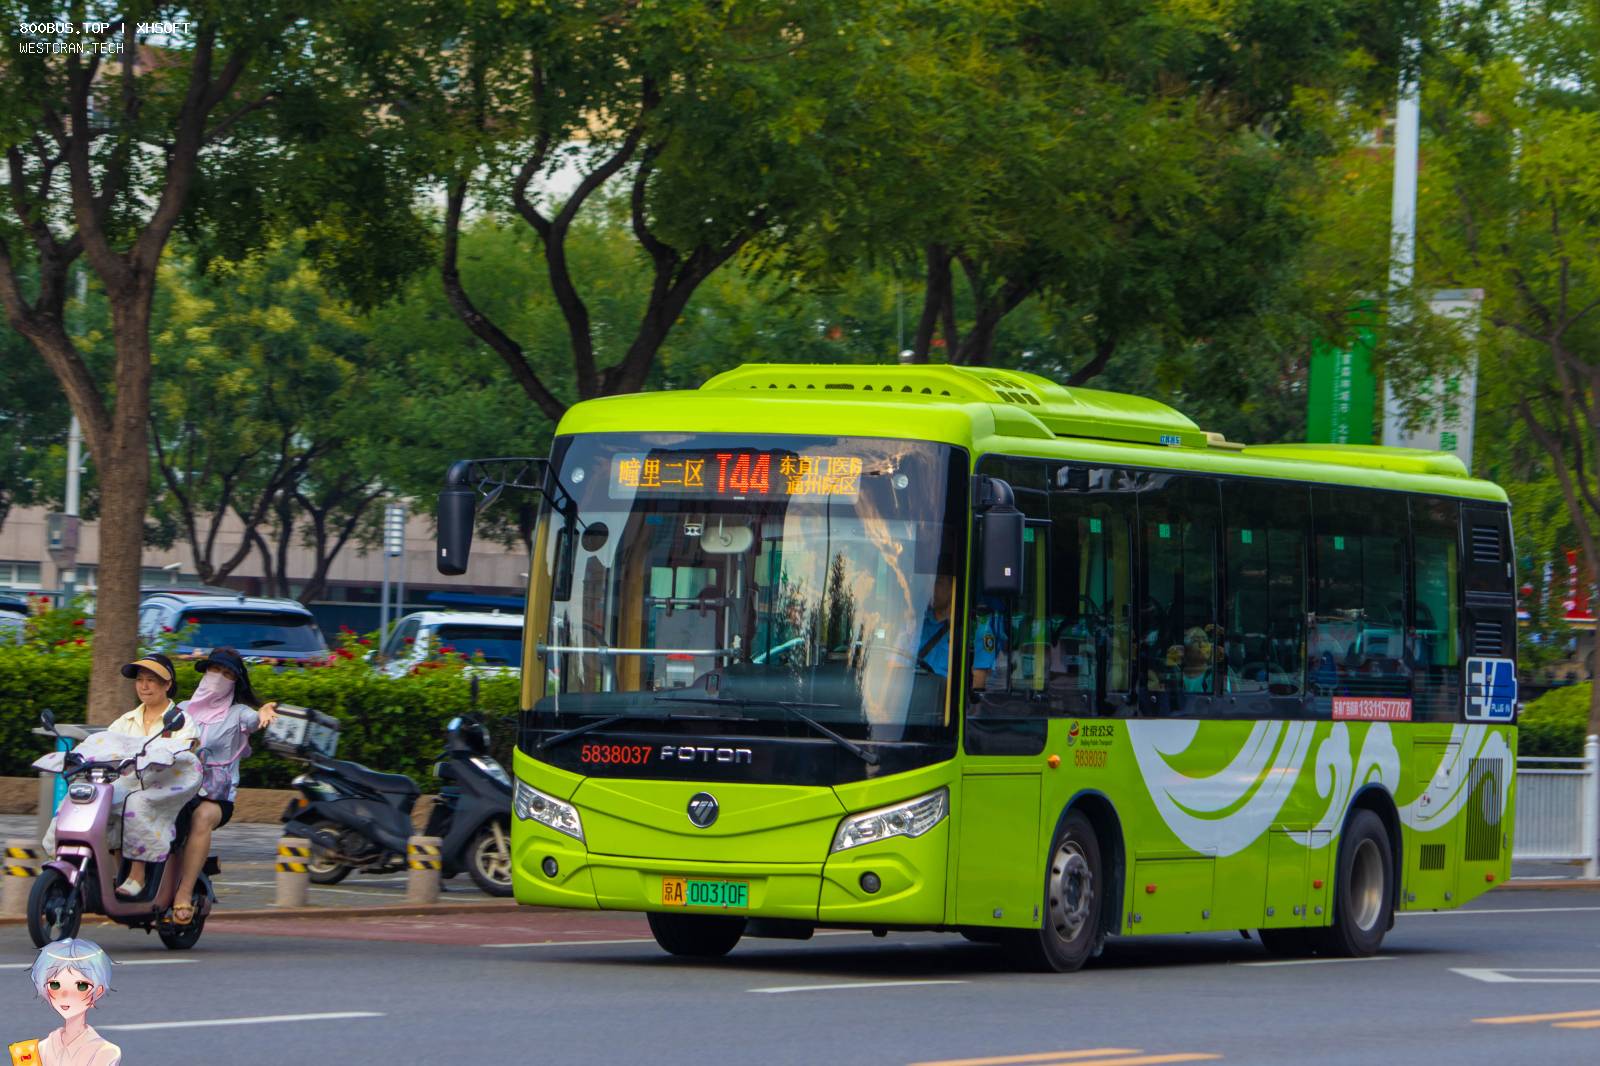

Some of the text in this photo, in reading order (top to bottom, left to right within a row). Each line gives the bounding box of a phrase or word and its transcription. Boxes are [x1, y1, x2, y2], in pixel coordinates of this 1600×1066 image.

[716, 453, 771, 494] T44
[784, 474, 858, 496] 通州院区
[1081, 724, 1115, 737] 北京公交
[580, 744, 652, 765] 5838037
[660, 745, 753, 764] FOTON
[1075, 750, 1108, 769] 5838037
